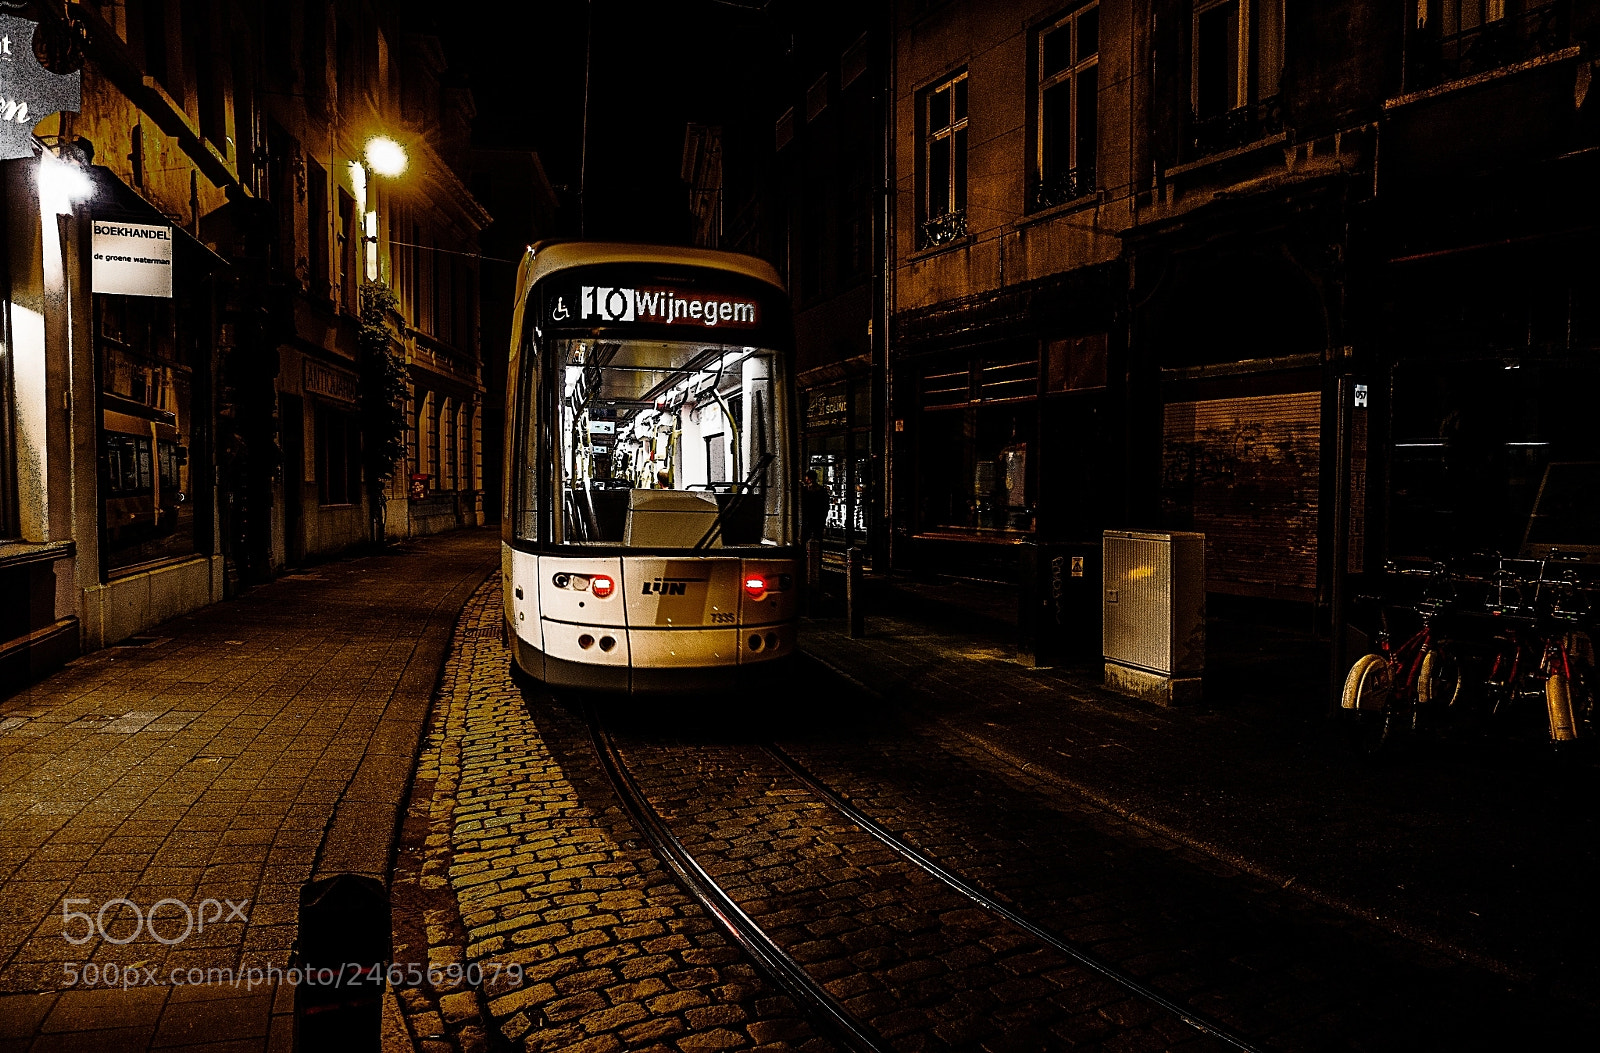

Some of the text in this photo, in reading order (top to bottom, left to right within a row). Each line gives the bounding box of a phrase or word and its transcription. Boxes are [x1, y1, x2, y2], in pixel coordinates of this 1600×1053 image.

[94, 225, 170, 241] BOEKHANDEL
[133, 257, 170, 265] waterman
[585, 286, 754, 326] 10 Wijnegem
